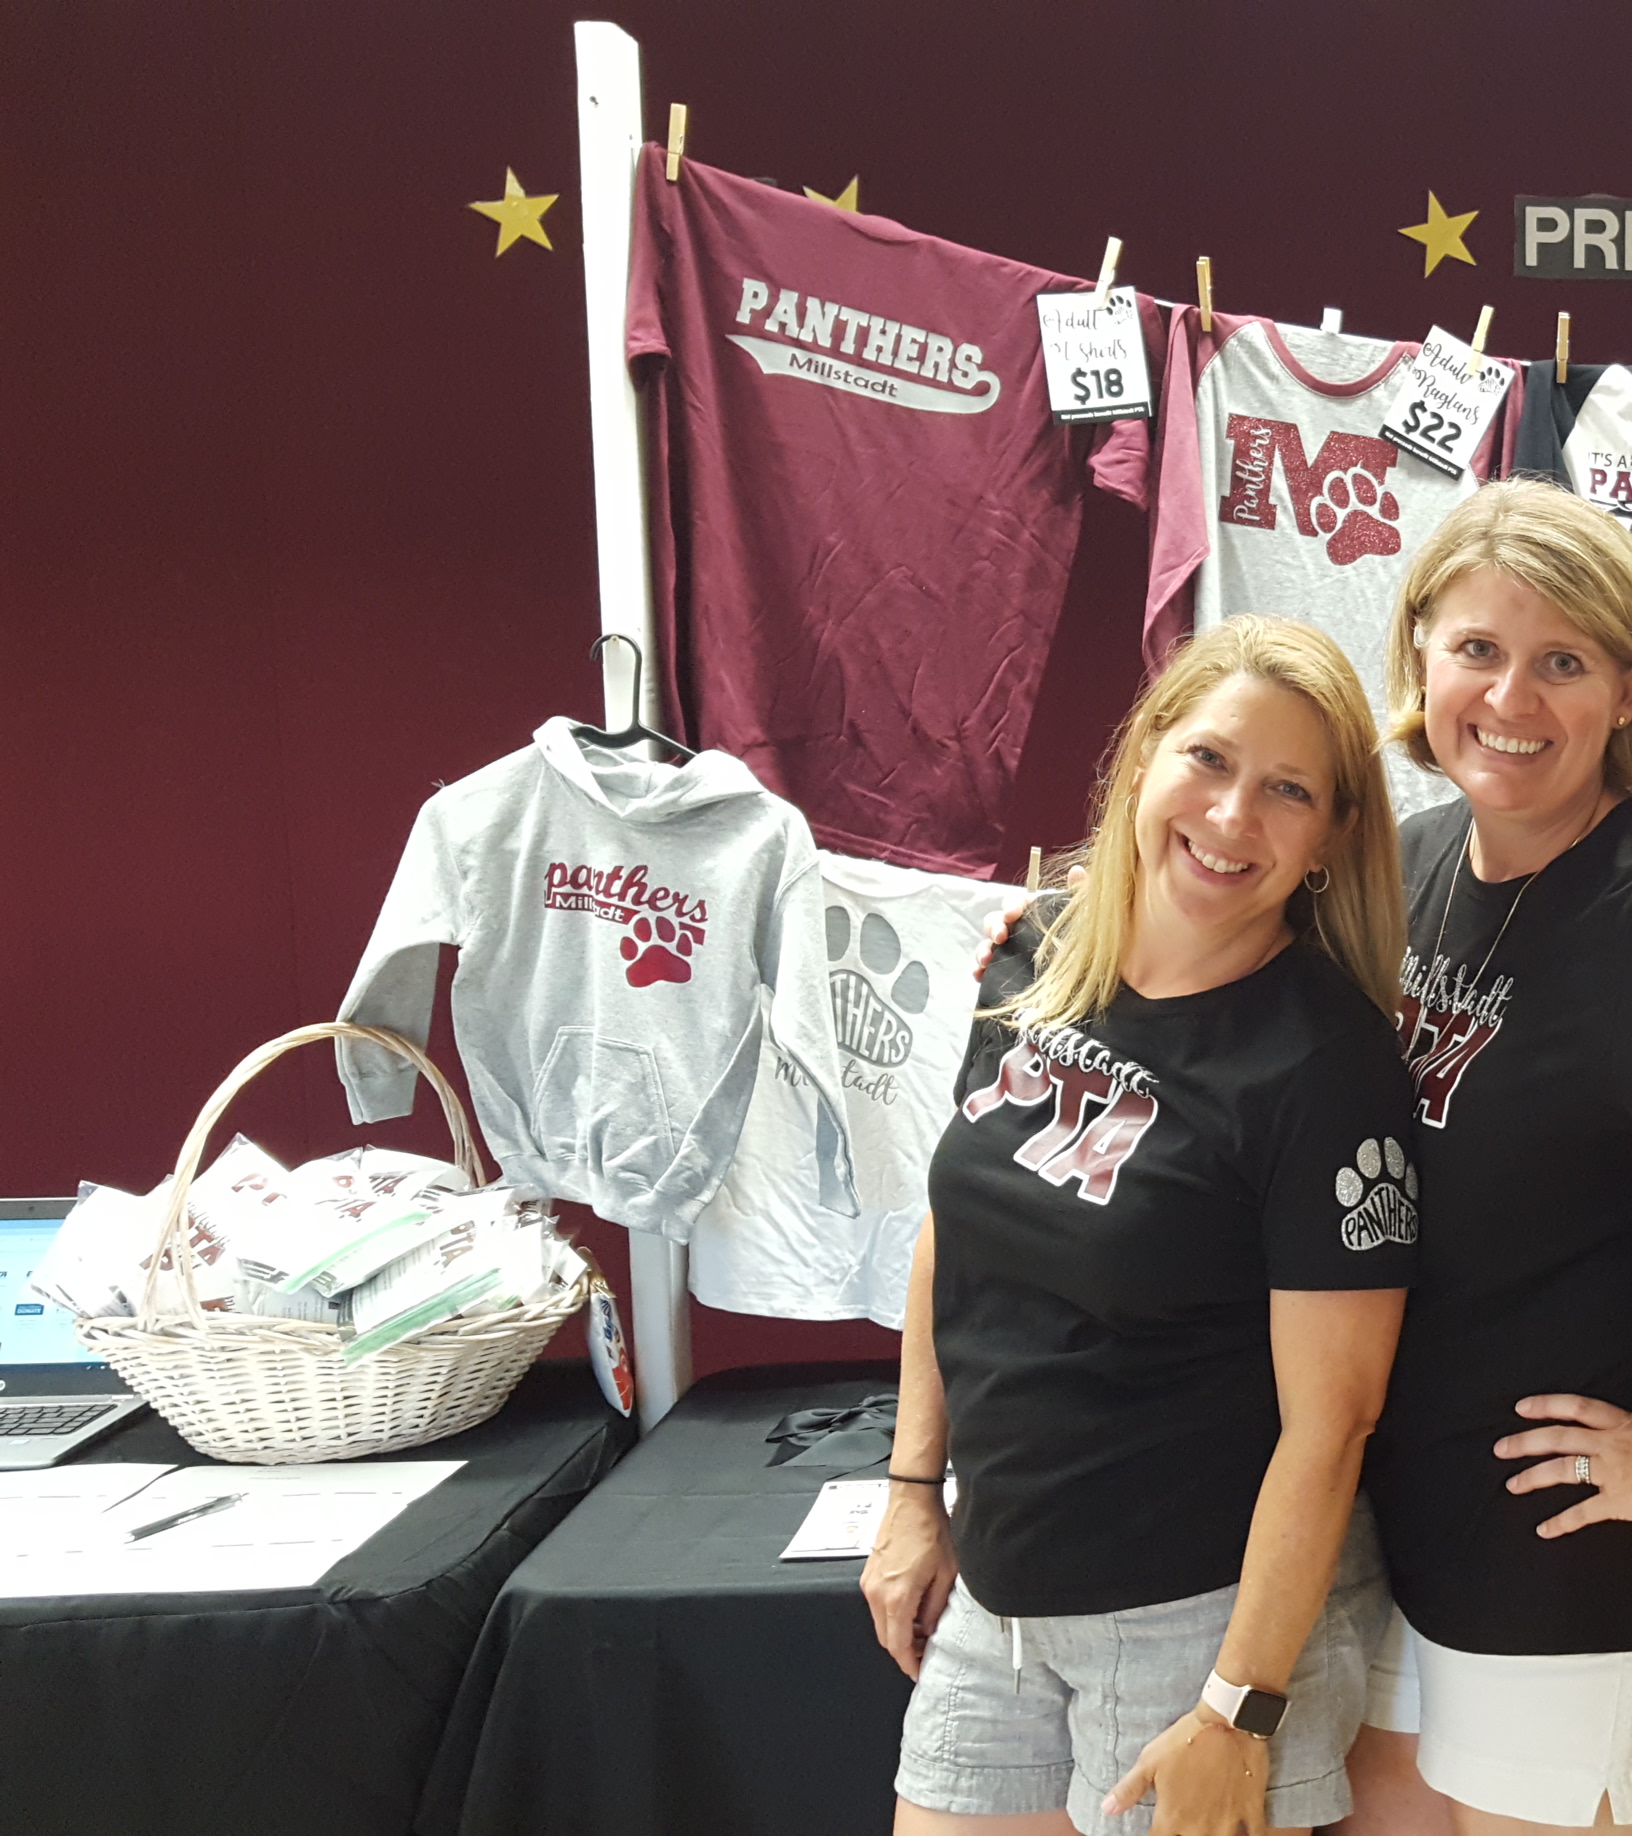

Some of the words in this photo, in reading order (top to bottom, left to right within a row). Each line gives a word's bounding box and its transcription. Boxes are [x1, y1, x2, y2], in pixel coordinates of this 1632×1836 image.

[735, 277, 990, 389] PANTHERS
[788, 351, 899, 399] Millstadt
[1070, 367, 1124, 405] $18
[1413, 366, 1481, 426] Raglans
[1401, 399, 1463, 454] $22
[1232, 426, 1273, 523] Panthers
[1588, 451, 1613, 466] IT'S
[1616, 454, 1628, 468] A
[544, 861, 709, 924] panthers
[963, 1040, 1159, 1206] PTA
